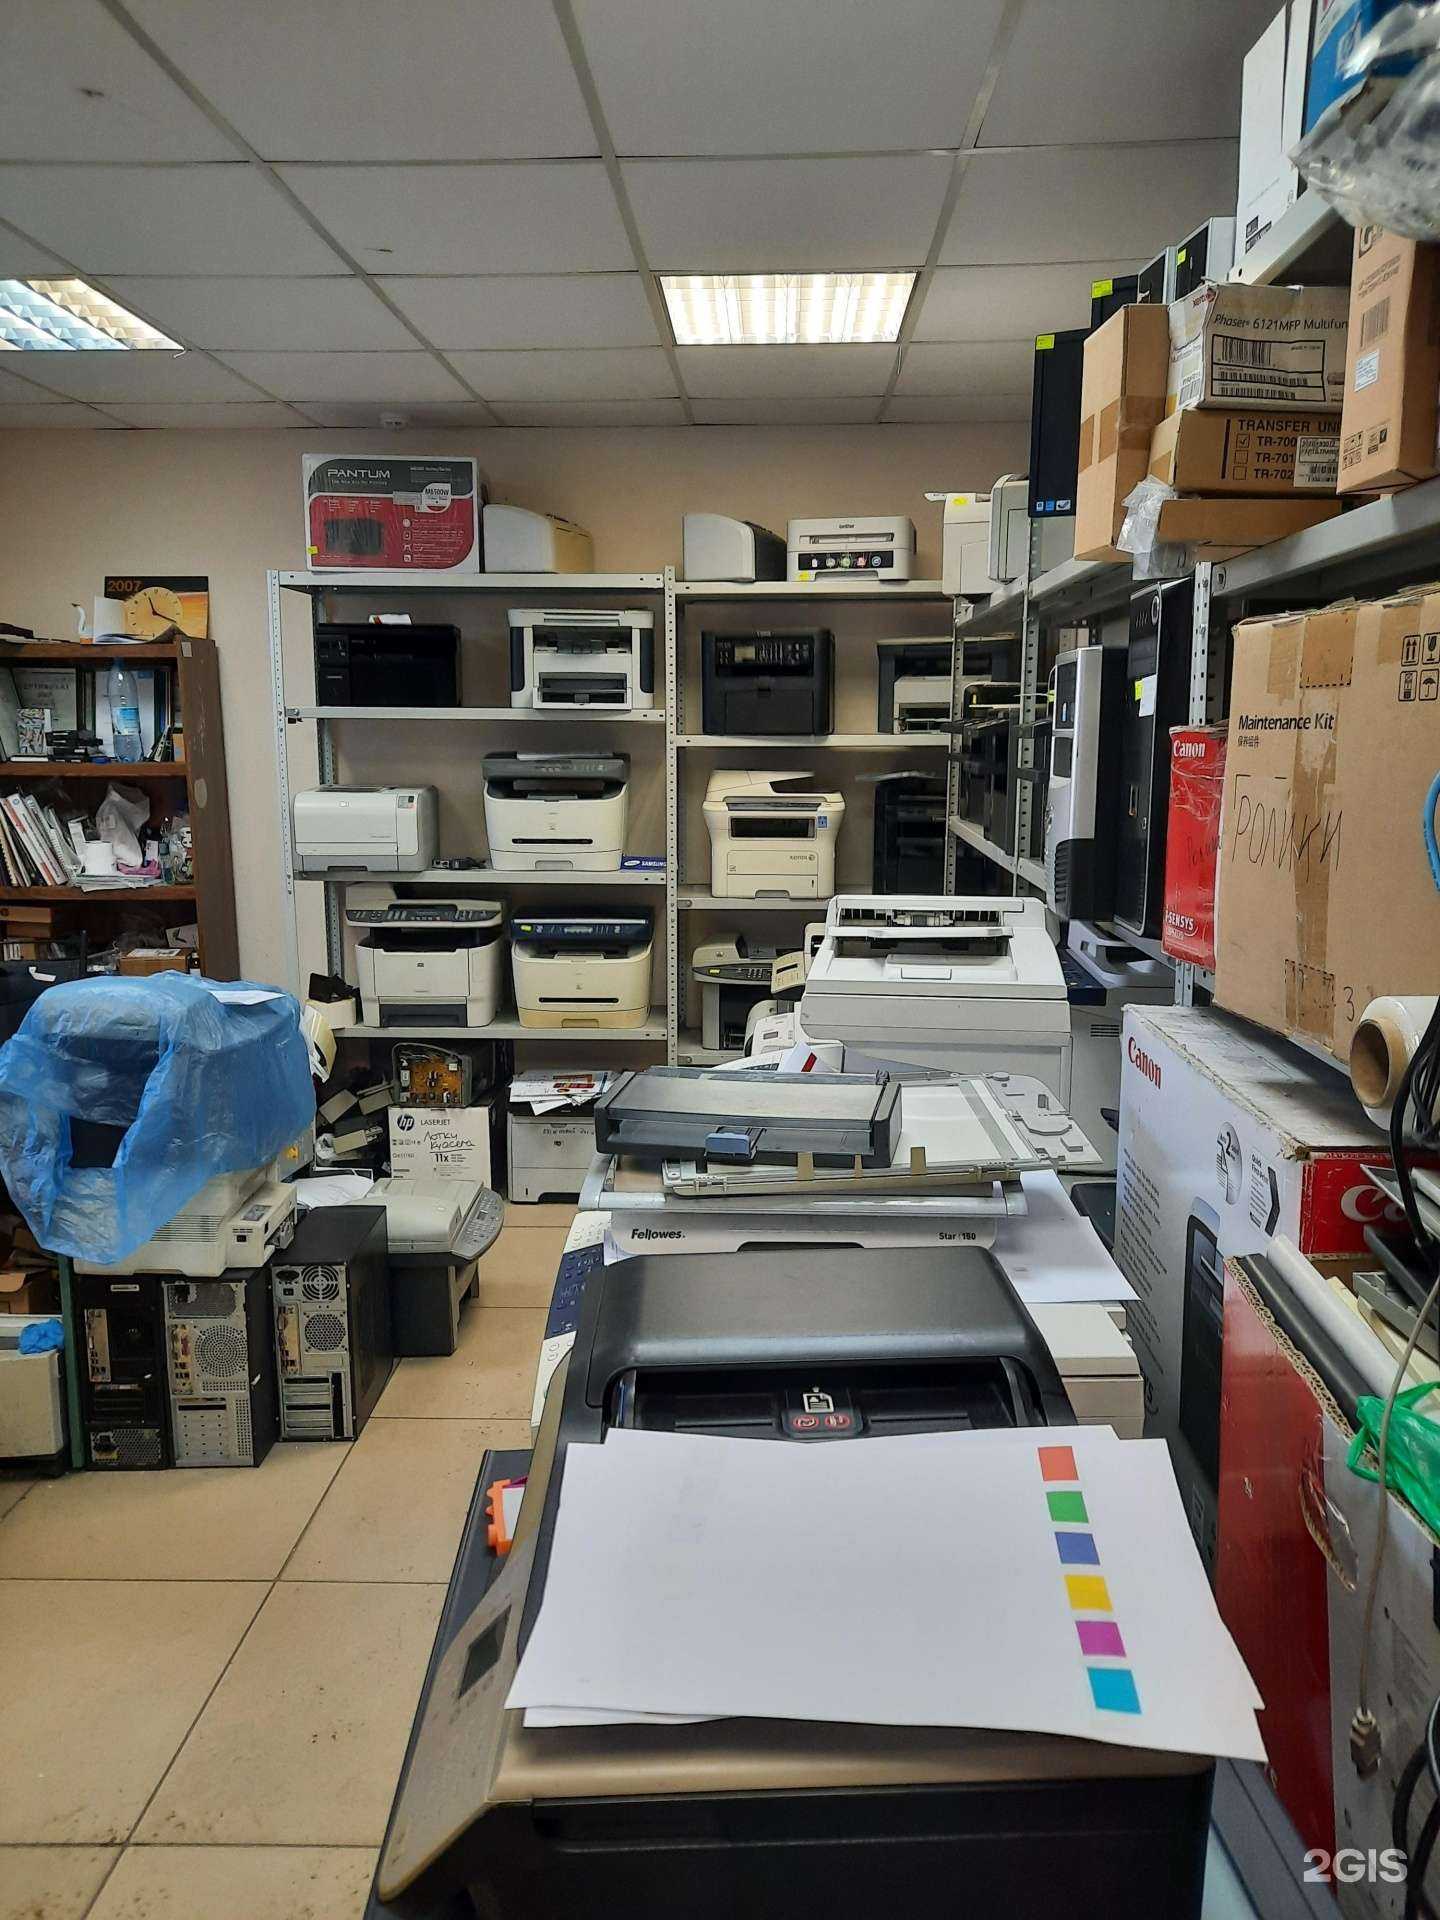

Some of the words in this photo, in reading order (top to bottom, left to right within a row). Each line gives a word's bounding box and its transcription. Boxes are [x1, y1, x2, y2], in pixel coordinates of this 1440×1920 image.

[1253, 318, 1300, 332] 6121MFP
[1238, 419, 1310, 433] TRANSFER
[1257, 436, 1298, 448] TR-700
[1255, 452, 1295, 464] TR-701
[327, 468, 391, 479] PANTUM
[1253, 468, 1295, 480] TR-702
[107, 581, 141, 591] 2007
[1238, 714, 1311, 730] Maintenance
[1314, 712, 1335, 730] Kit
[1172, 740, 1206, 758] Canon
[1128, 1036, 1162, 1090] Canon
